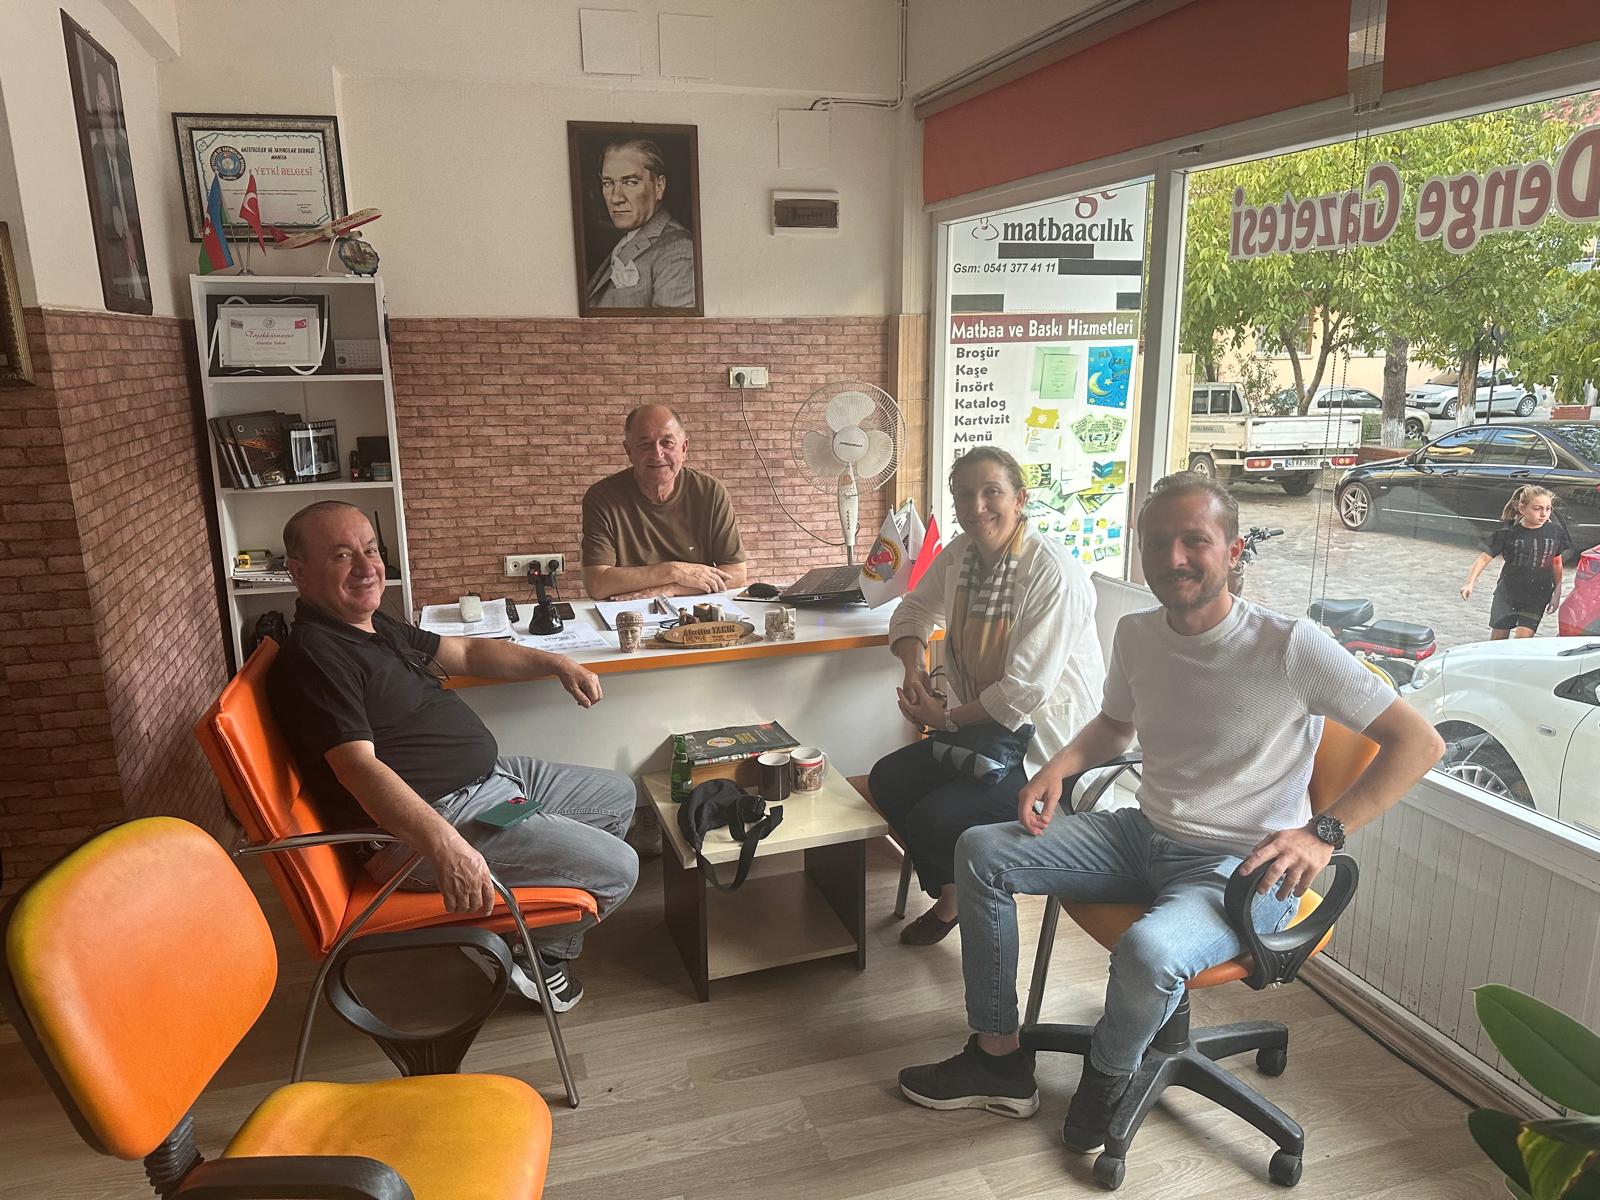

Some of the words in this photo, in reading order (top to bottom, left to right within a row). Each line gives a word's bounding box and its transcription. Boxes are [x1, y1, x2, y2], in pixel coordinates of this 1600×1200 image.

[254, 166, 279, 176] YETKİ
[281, 166, 313, 176] BELGESİ
[1002, 217, 1134, 242] matbaacılık
[953, 264, 980, 274] Gsm:
[984, 263, 1009, 273] 0541
[1010, 263, 1028, 273] 377
[1030, 263, 1042, 273] 41
[1046, 262, 1056, 273] 11
[951, 320, 1004, 339] Matbaa
[1009, 326, 1024, 337] ve
[1030, 320, 1062, 336] Baskı
[1067, 319, 1133, 336] Hizmetleri
[956, 347, 1000, 361] Broşür
[956, 364, 988, 378] Kaşe
[955, 379, 994, 392] İnsört
[954, 397, 1006, 411] Katalog
[954, 414, 1010, 426] Kartvizit
[954, 431, 993, 443] Menü
